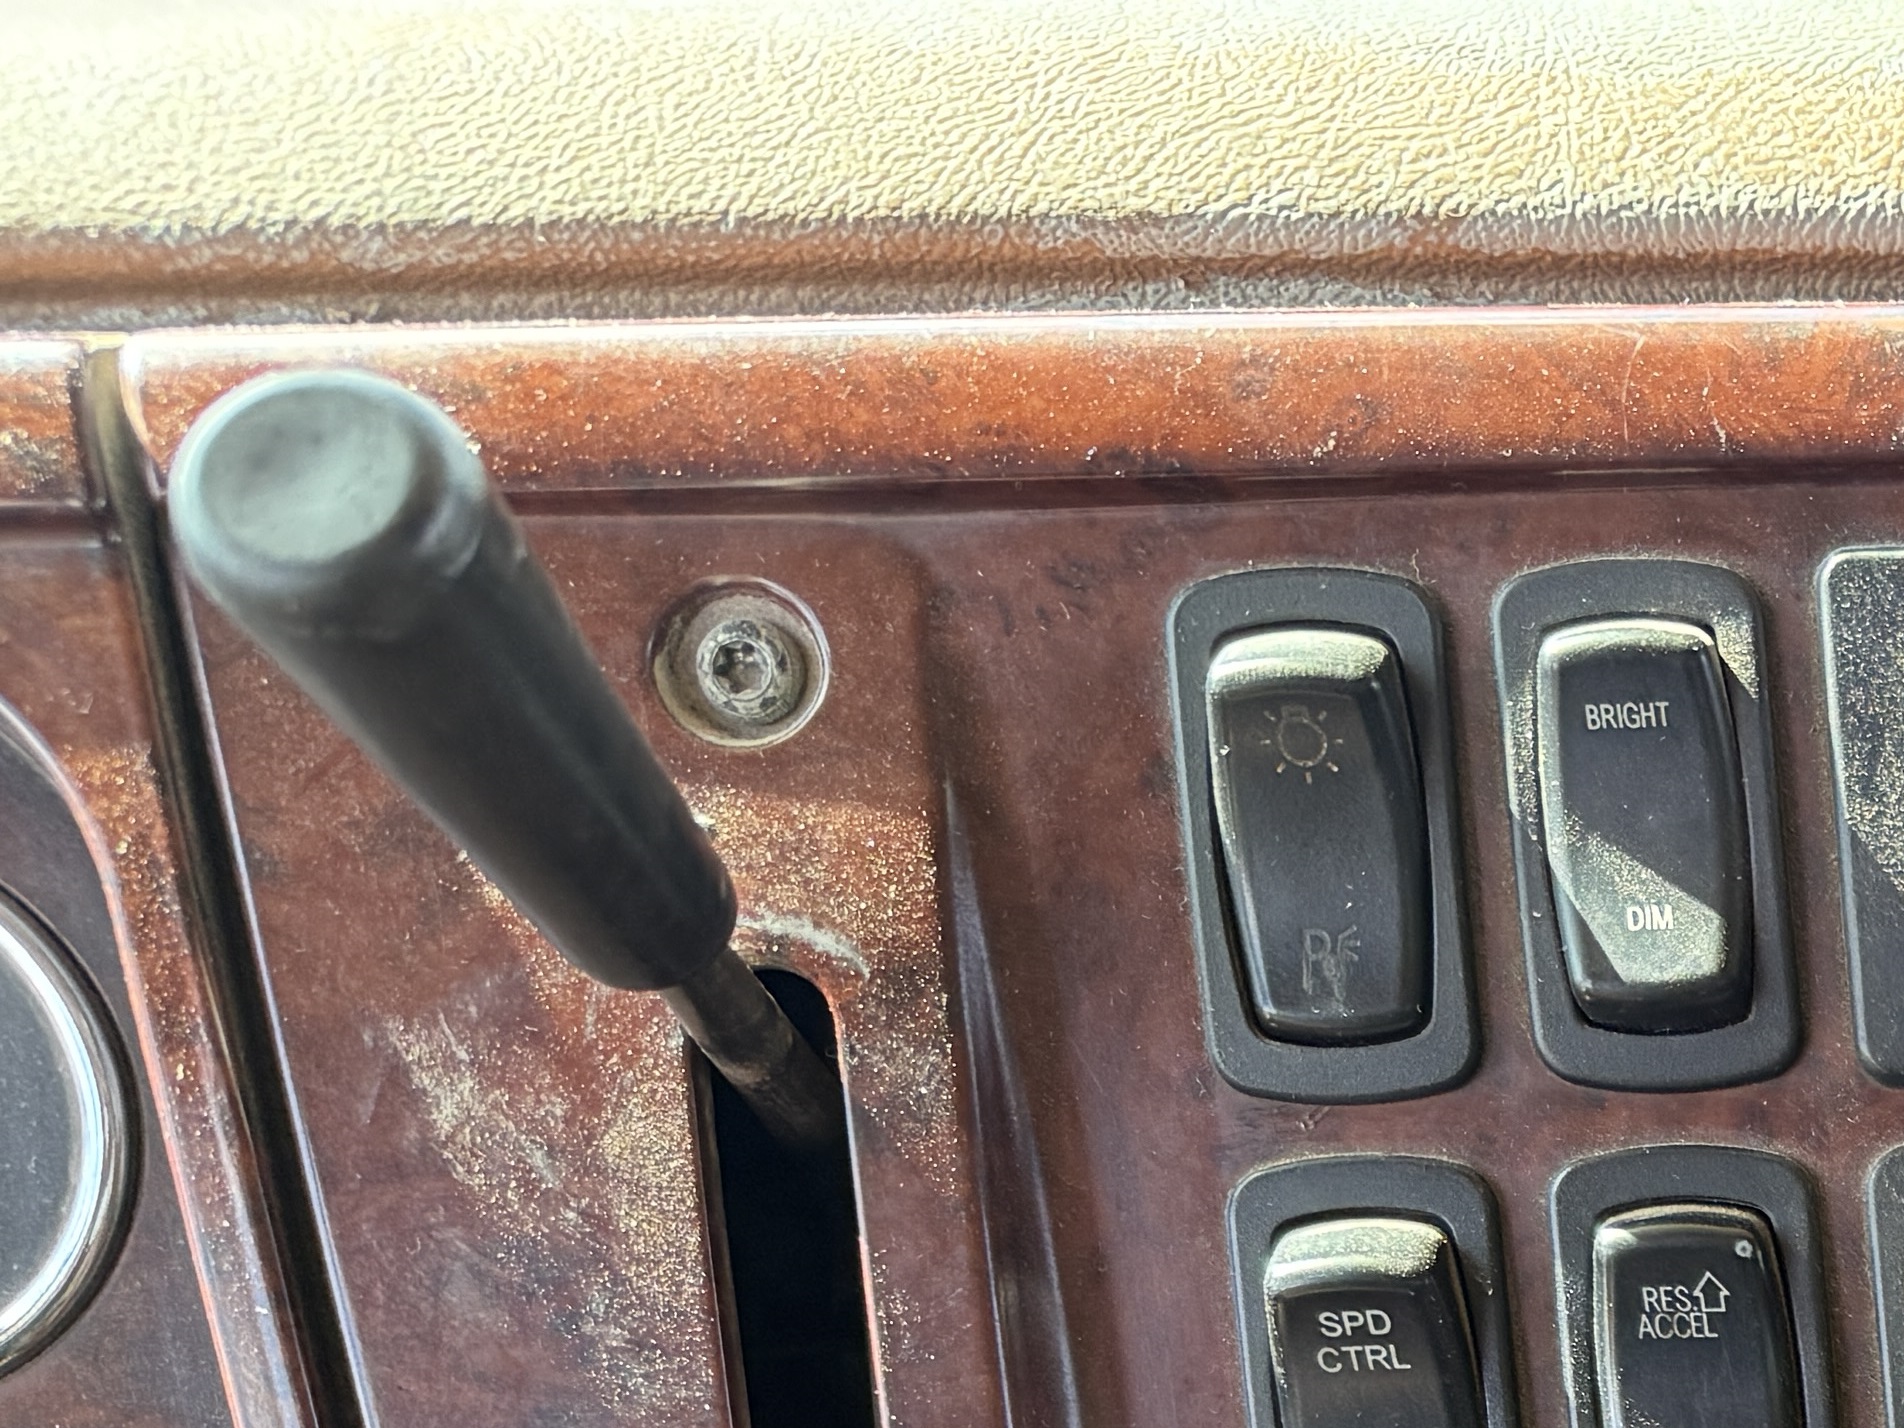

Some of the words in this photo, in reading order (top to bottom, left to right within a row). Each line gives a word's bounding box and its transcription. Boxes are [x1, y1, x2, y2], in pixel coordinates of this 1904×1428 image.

[1585, 702, 1669, 731] BRIGHT
[1626, 904, 1674, 932] DIM
[1318, 1309, 1392, 1339] SPD
[1637, 1310, 1719, 1341] ACCEL
[1315, 1341, 1411, 1374] CTRL
